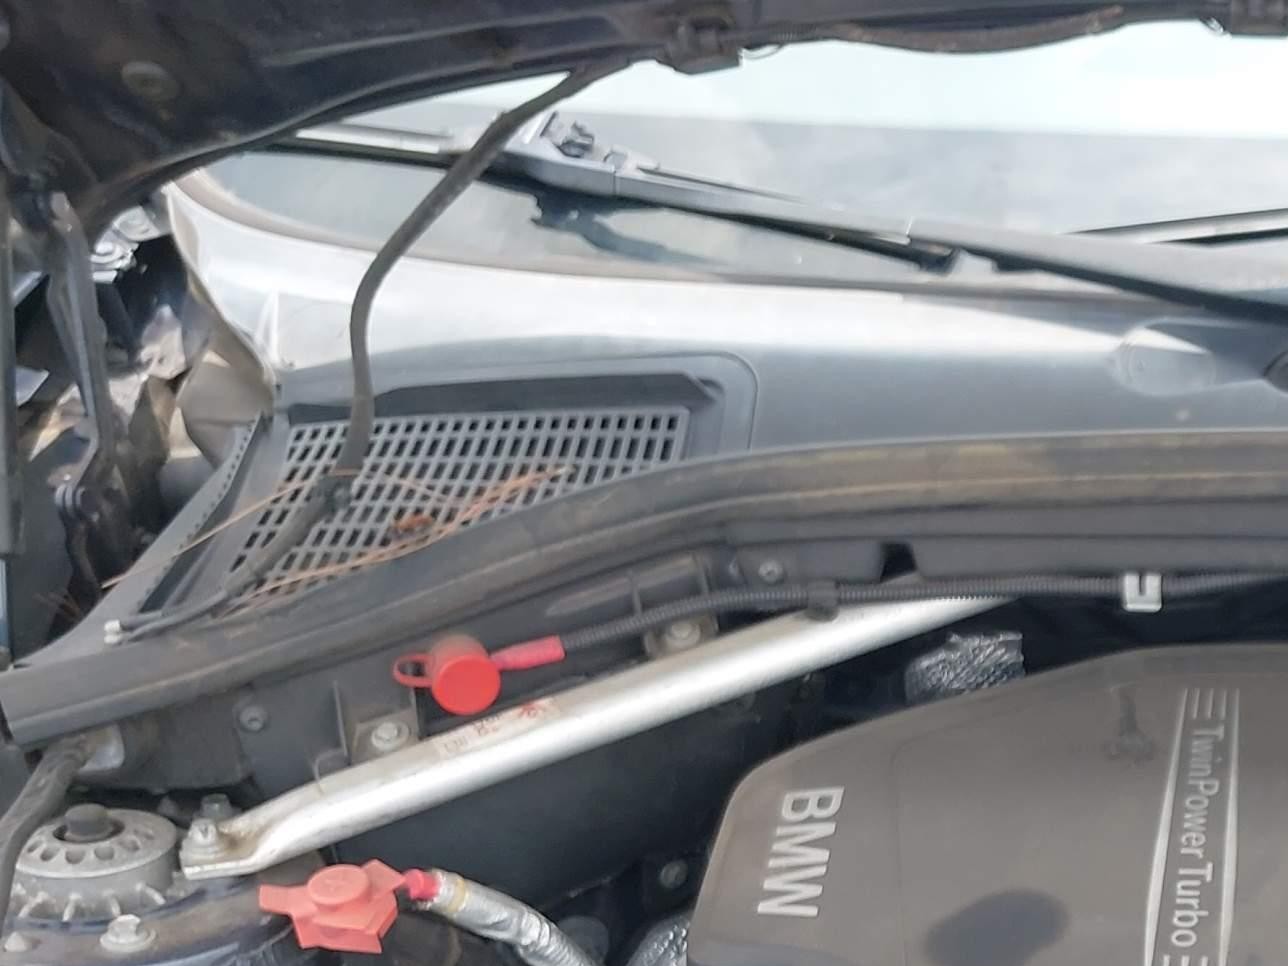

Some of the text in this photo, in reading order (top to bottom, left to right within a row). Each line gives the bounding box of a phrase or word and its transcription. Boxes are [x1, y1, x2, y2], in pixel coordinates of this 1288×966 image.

[757, 786, 845, 917] BMW
[1171, 723, 1225, 948] TwinPower Turbo
